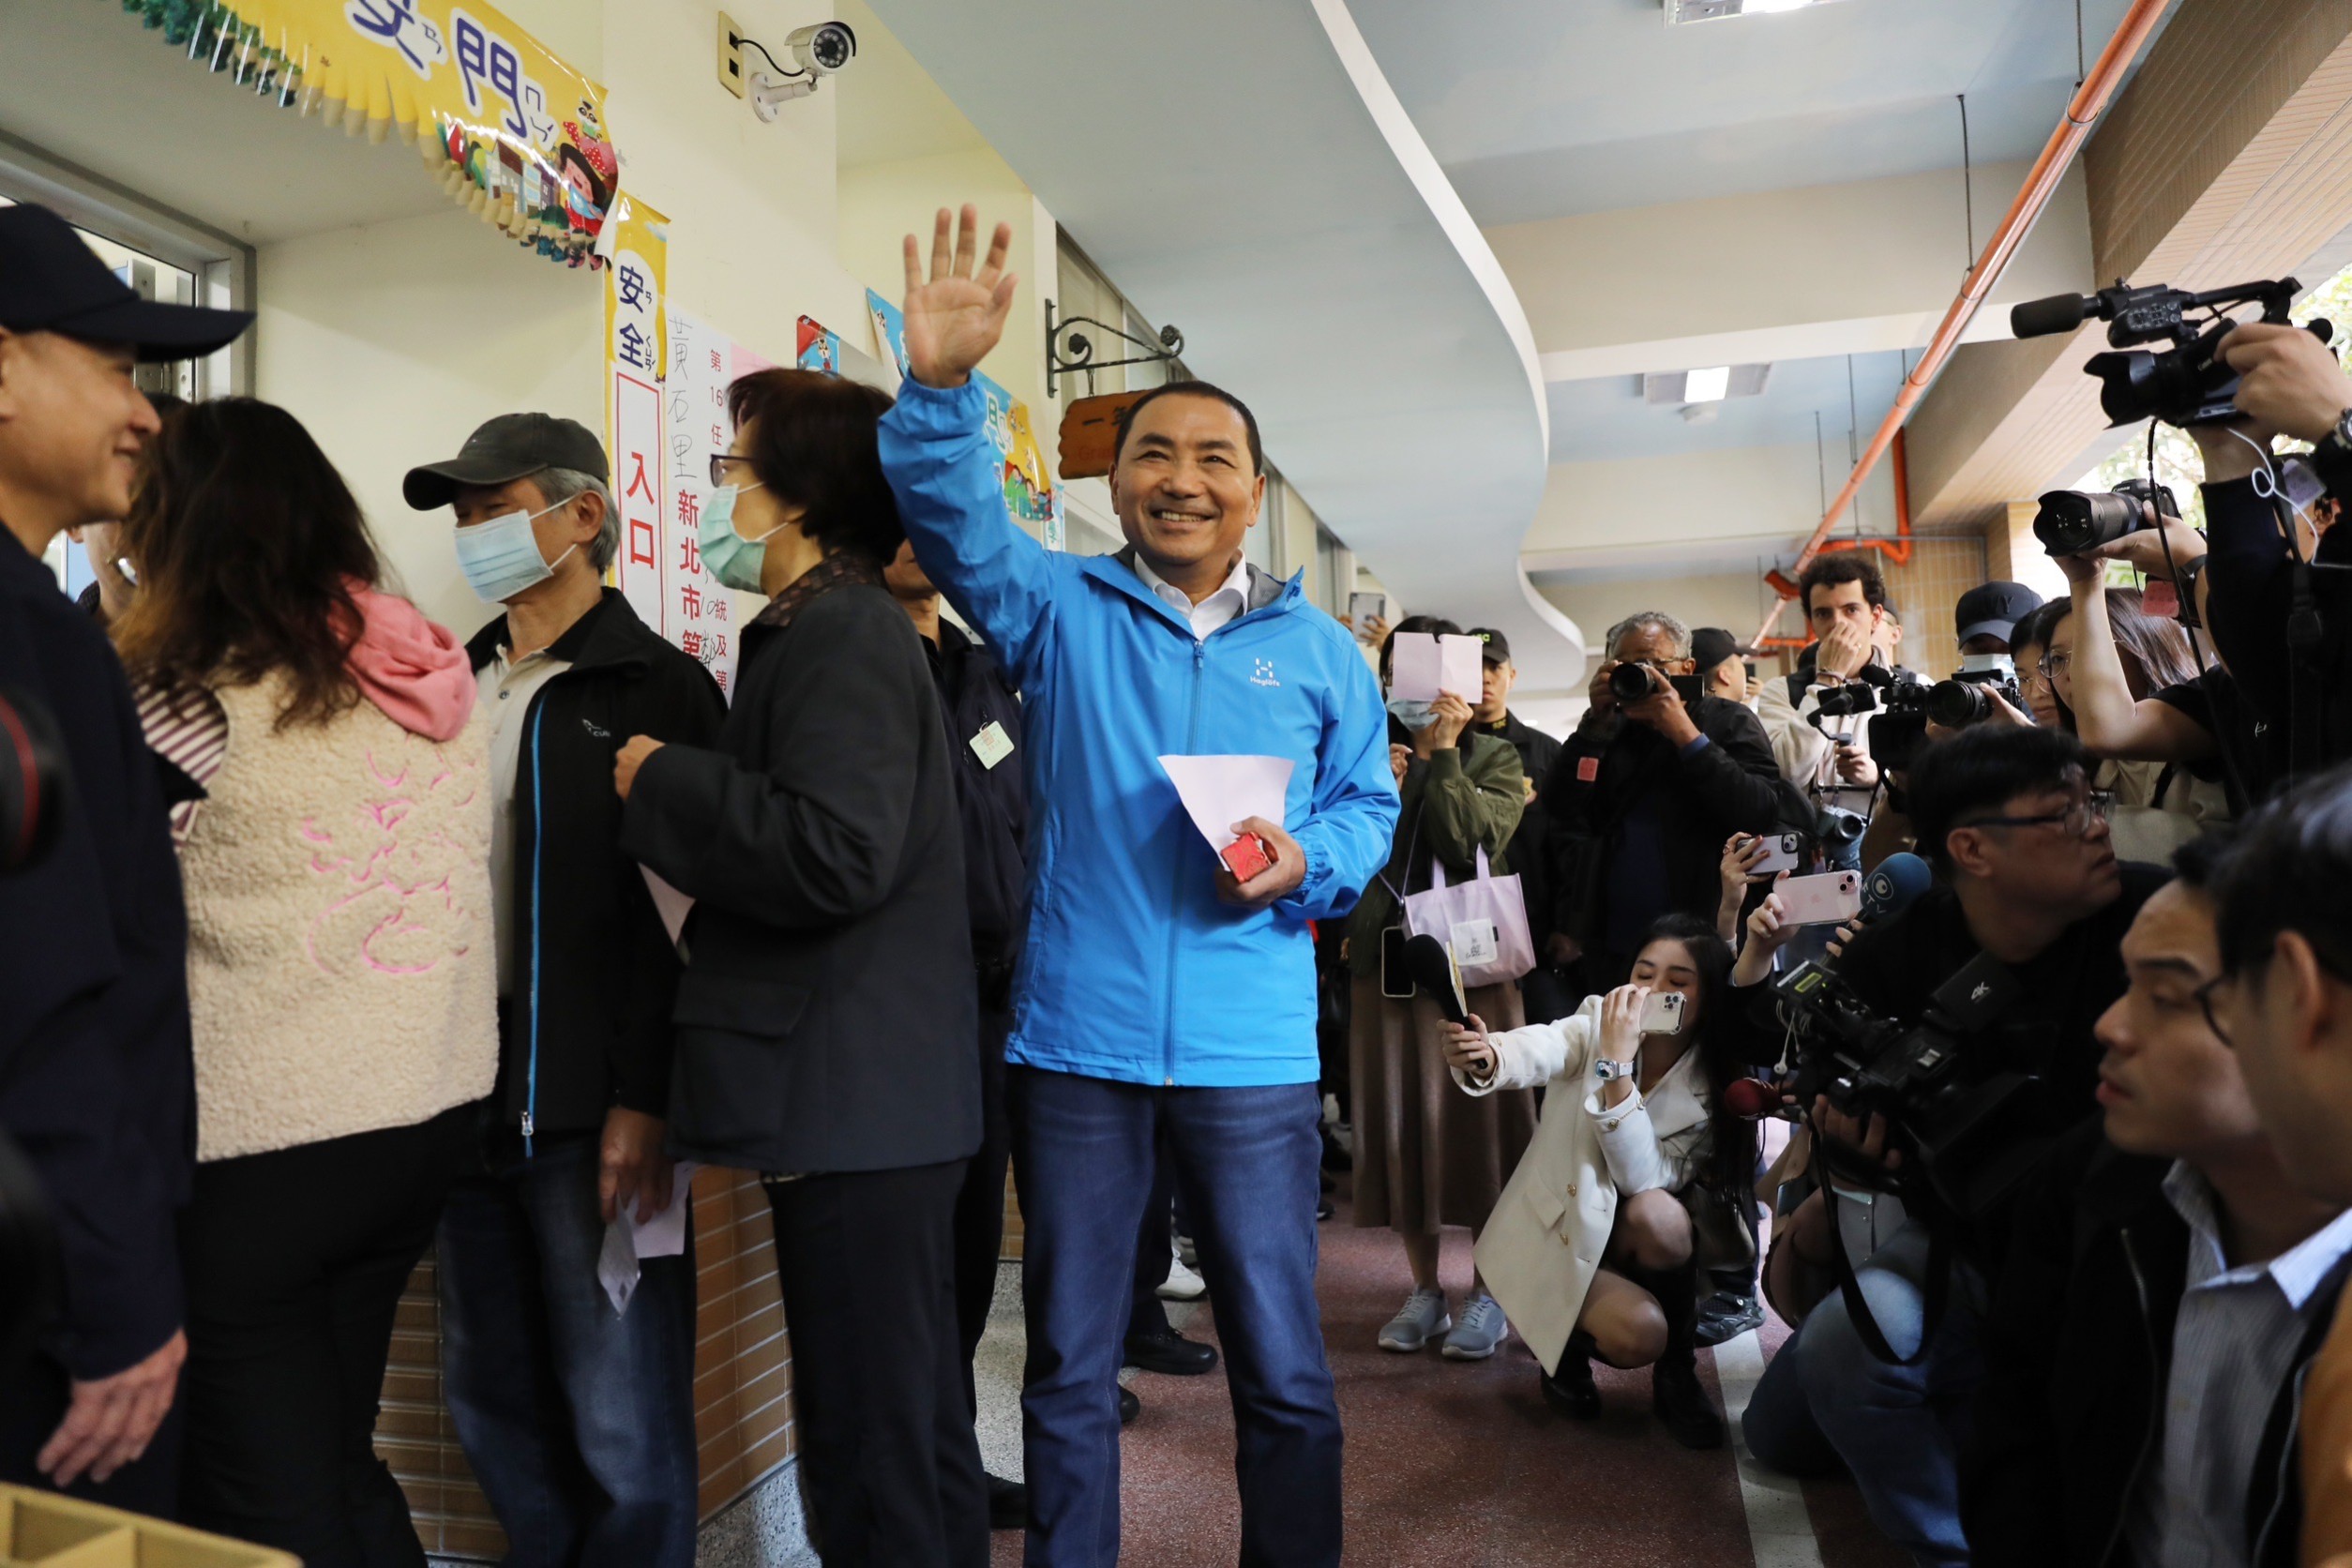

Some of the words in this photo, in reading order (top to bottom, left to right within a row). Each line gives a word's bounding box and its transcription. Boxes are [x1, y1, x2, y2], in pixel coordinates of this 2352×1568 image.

[619, 264, 644, 369] 安全
[626, 451, 655, 570] 入口
[715, 576, 728, 692] 統及第
[1249, 675, 1281, 687] Haglöfs
